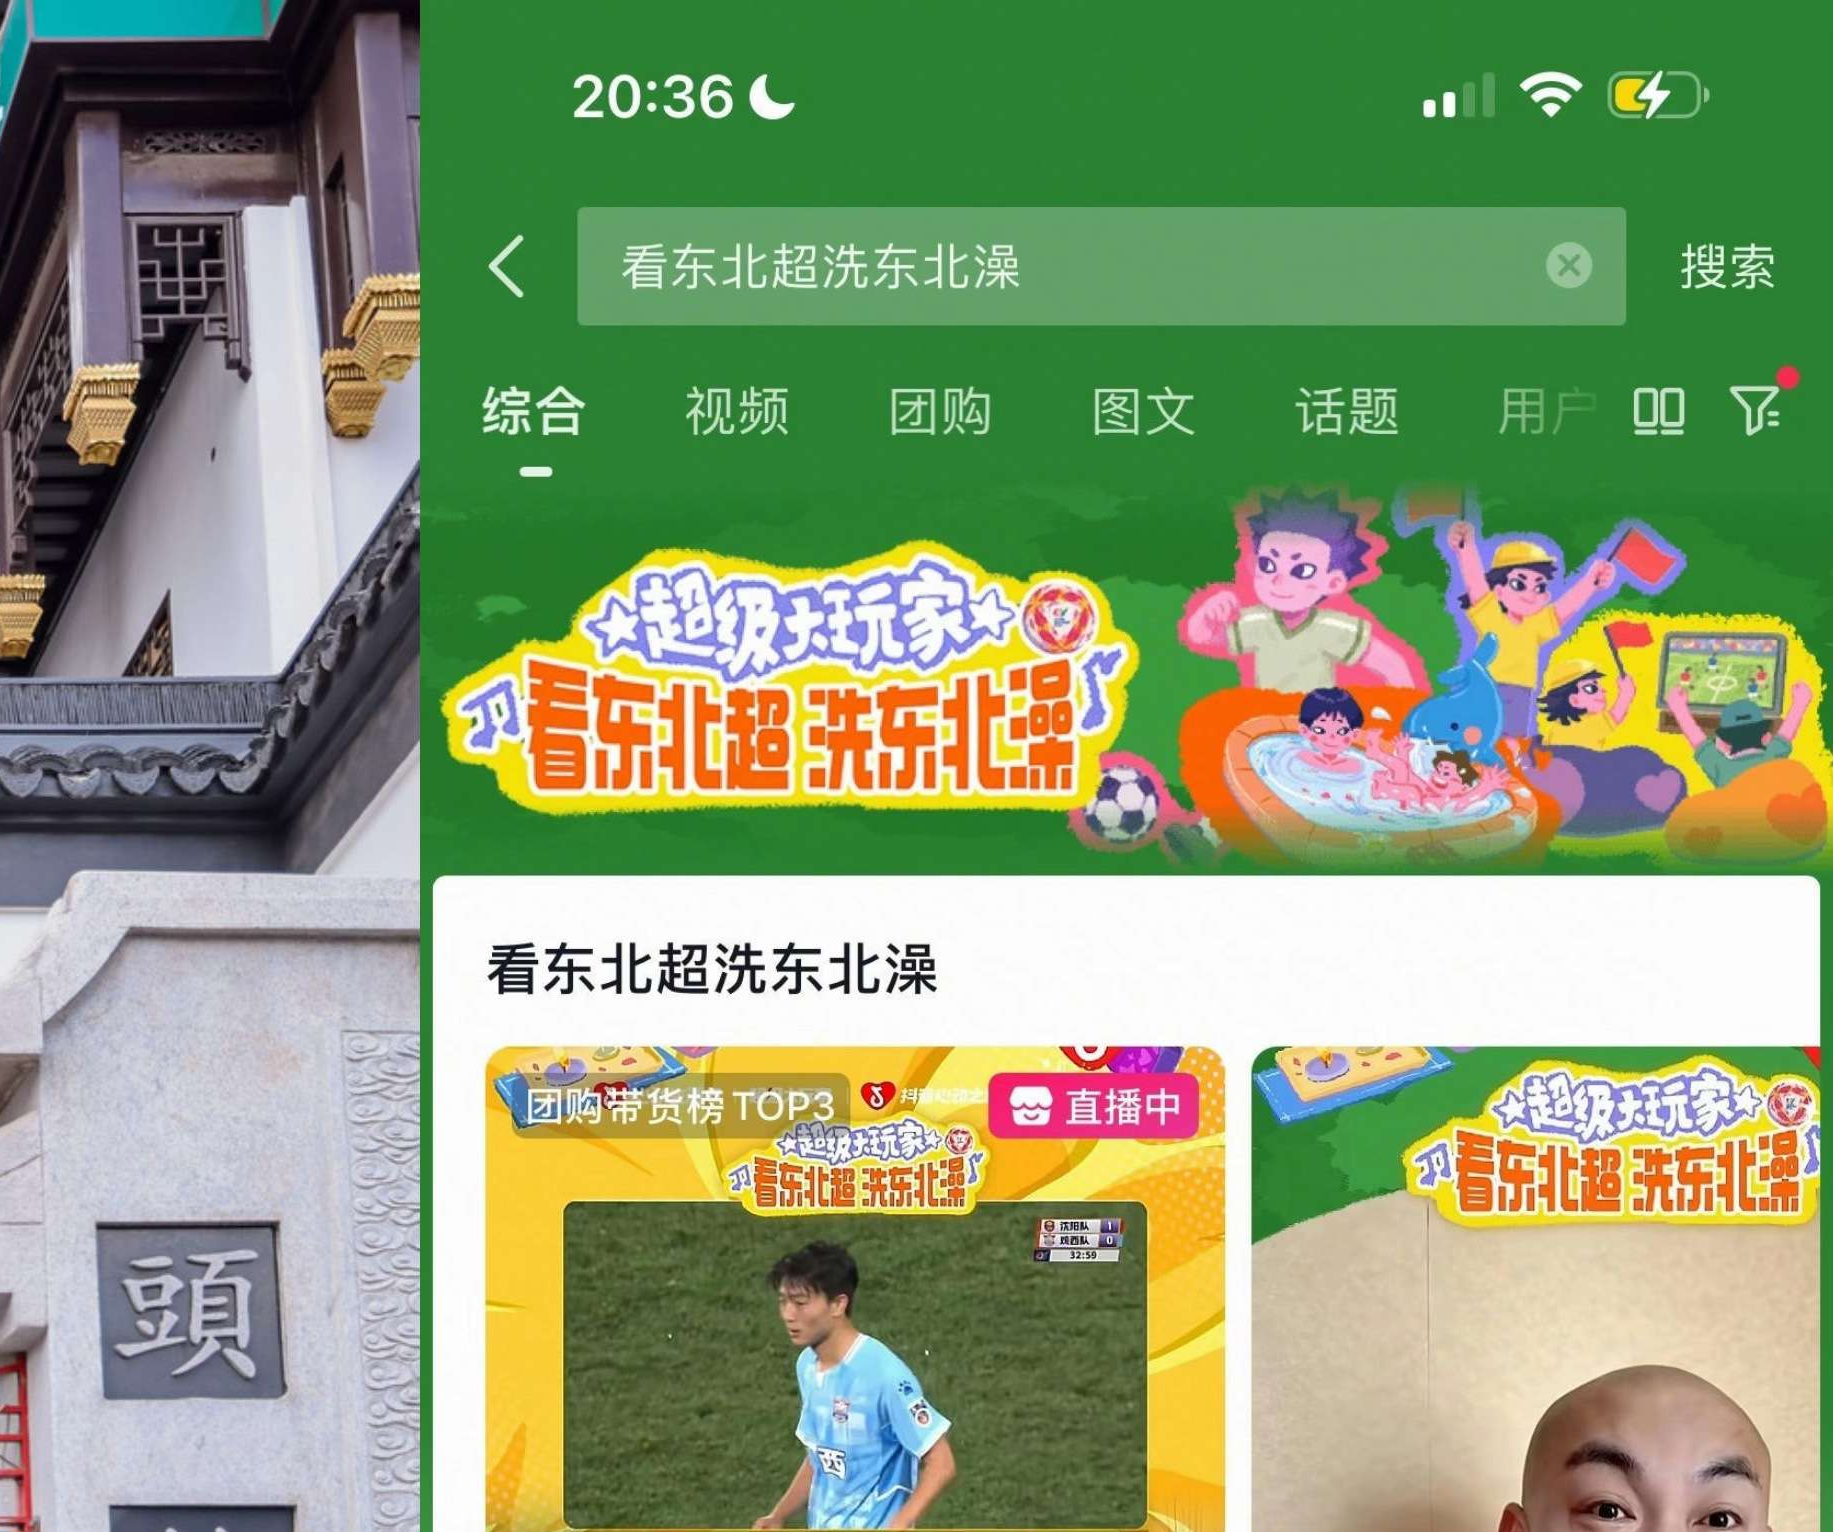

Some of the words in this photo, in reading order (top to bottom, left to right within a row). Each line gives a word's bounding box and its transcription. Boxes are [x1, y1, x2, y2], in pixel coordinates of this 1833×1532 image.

[571, 73, 736, 120] 20:36
[620, 243, 1021, 293] 看东北超洗东北澡
[1680, 242, 1776, 293] 搜索
[482, 386, 586, 438] 综合
[685, 386, 789, 438] 视频
[889, 386, 992, 438] 团购
[1092, 386, 1196, 438] 图文
[1295, 386, 1399, 438] 话题
[1498, 387, 1596, 434] 用户
[634, 562, 987, 682] 超级大玩家
[527, 661, 792, 794] 看东北超
[807, 658, 1079, 794] 洗东北澡
[486, 940, 939, 997] 看东北超洗东北澡
[526, 1087, 726, 1127] 团购带货榜
[732, 1089, 836, 1125] TOP3
[1065, 1086, 1182, 1127] 直播中
[1522, 1066, 1737, 1140] 超级大玩家
[793, 1119, 931, 1163] 超级大玩家
[752, 1155, 856, 1209] 看东北超
[861, 1155, 968, 1209] 洗东北澡
[1454, 1130, 1623, 1214] 看东北超
[1632, 1130, 1801, 1214] 洗东北澡
[1069, 1250, 1097, 1261] 32:59
